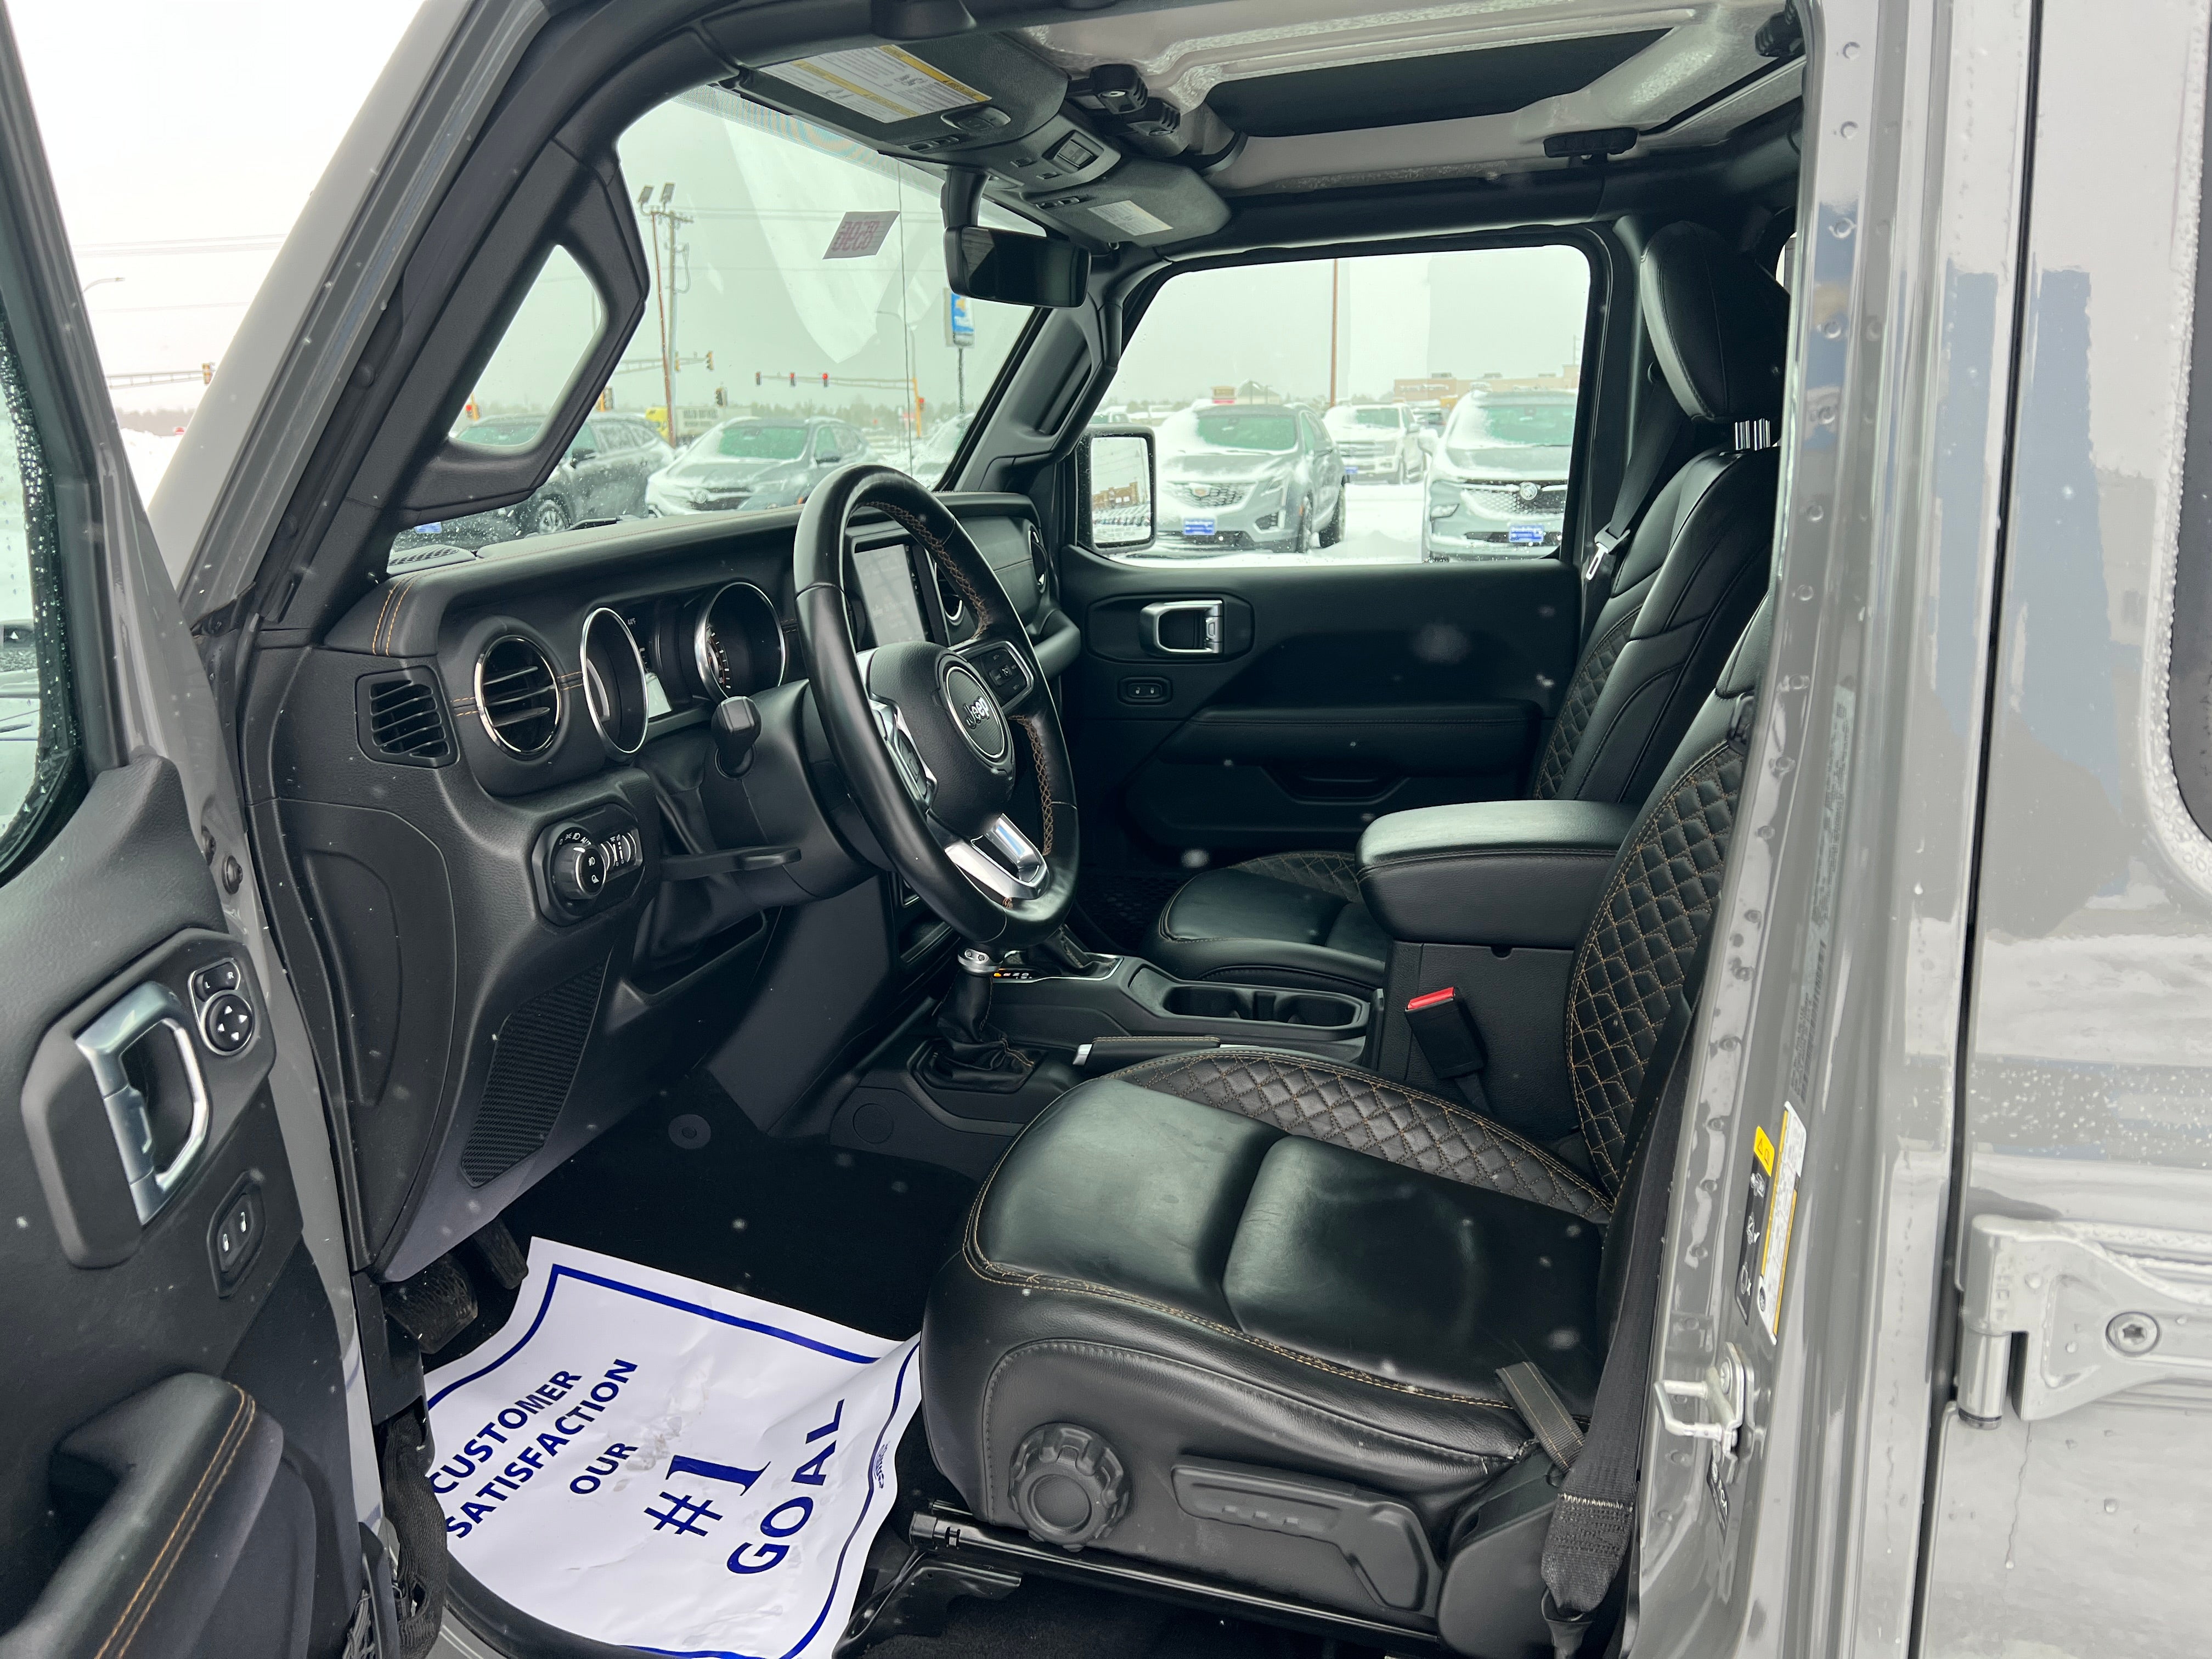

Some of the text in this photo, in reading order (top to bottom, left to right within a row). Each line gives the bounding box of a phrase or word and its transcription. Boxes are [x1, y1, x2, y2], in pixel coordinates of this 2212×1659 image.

[963, 696, 990, 730] Jeep
[428, 1370, 583, 1494] CUSTOMER
[446, 1358, 638, 1539] SATISFACTION
[569, 1442, 639, 1494] OUR
[644, 1454, 771, 1537] #1
[727, 1399, 844, 1574] GOAL
